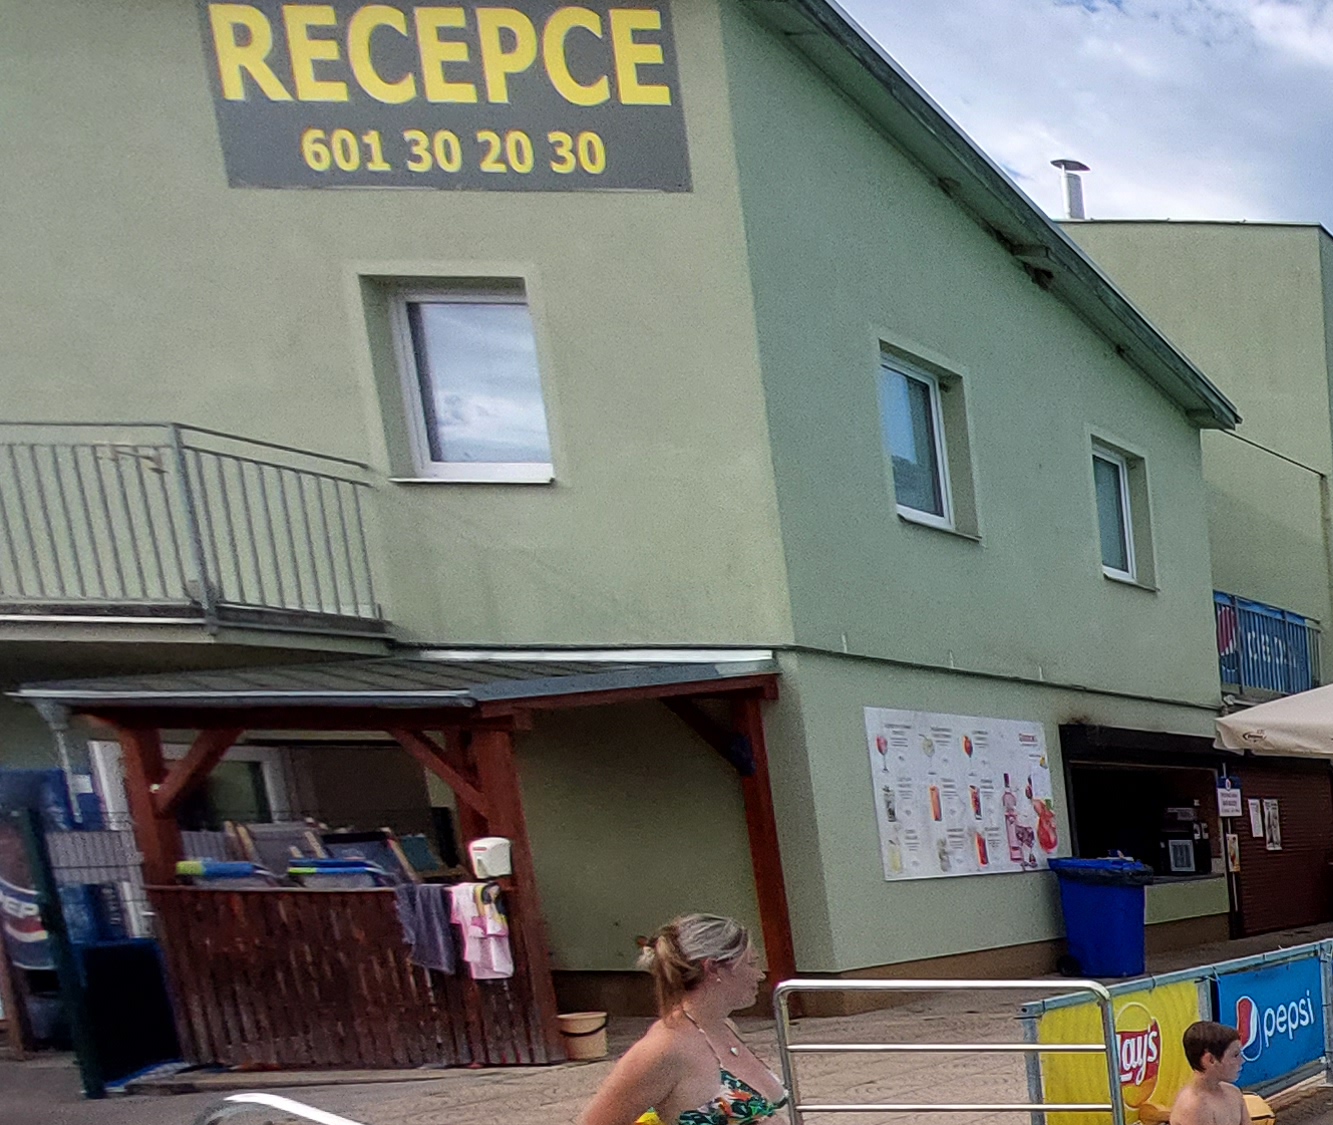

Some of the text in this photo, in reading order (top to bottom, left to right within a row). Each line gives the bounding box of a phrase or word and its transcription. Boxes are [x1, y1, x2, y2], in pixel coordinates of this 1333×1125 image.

[208, 3, 672, 106] RECEPCE
[302, 128, 606, 174] 601 30 20 30
[1263, 990, 1315, 1047] pepsi
